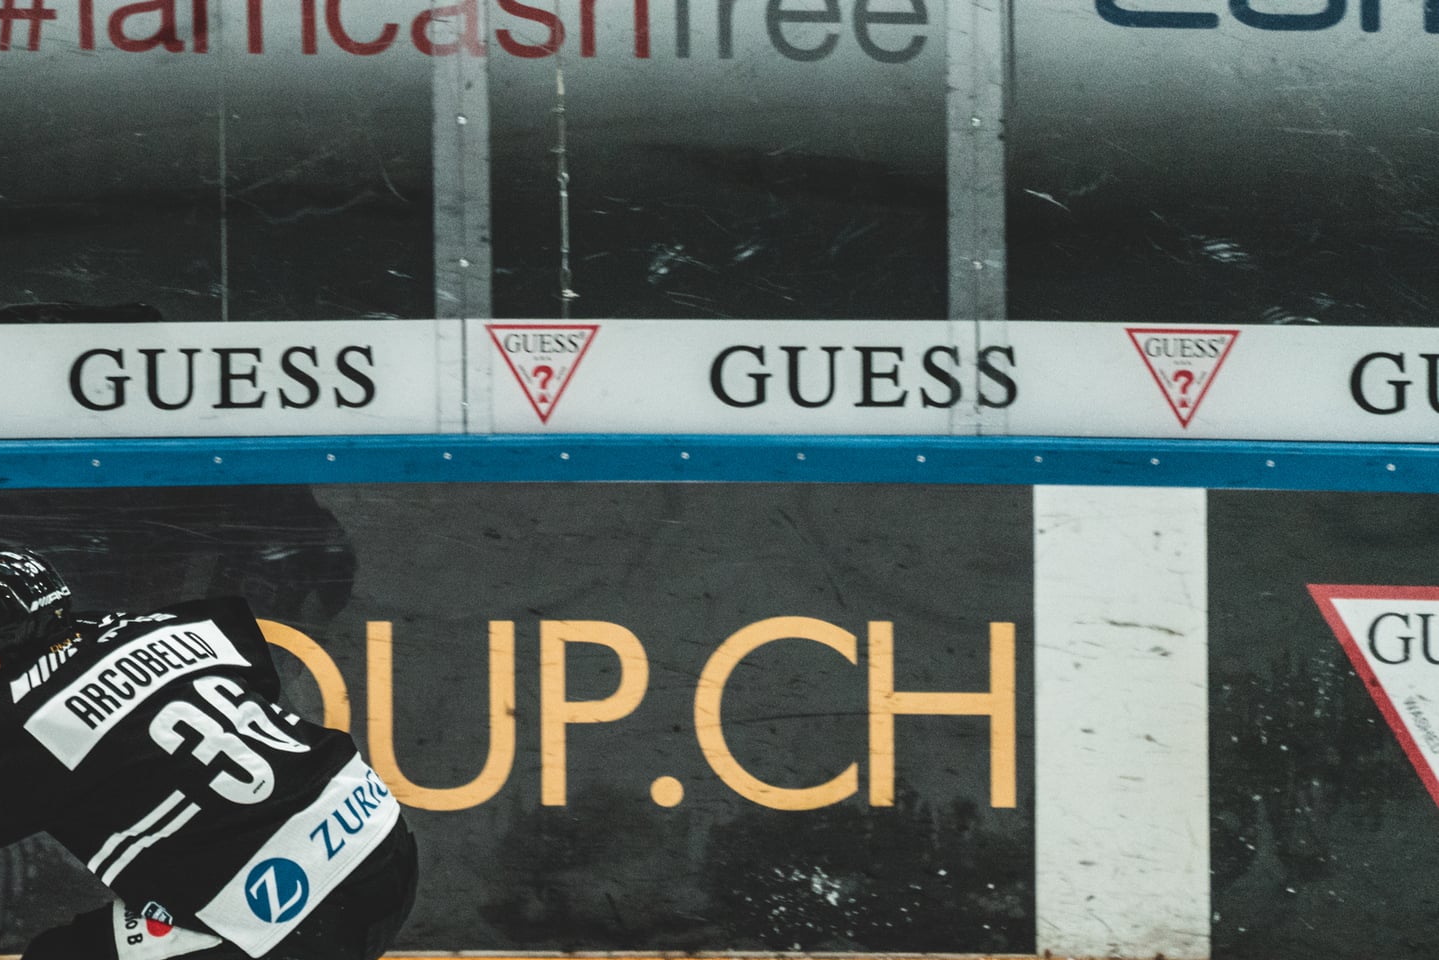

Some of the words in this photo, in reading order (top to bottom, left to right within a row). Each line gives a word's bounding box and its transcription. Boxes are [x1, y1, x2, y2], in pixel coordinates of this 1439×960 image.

[504, 333, 580, 353] GUESS
[1144, 337, 1220, 358] GUESS
[68, 345, 377, 412] GUESS
[709, 344, 1019, 409] GUESS
[64, 630, 218, 731] ARCOBELLO
[148, 675, 311, 805] 36
